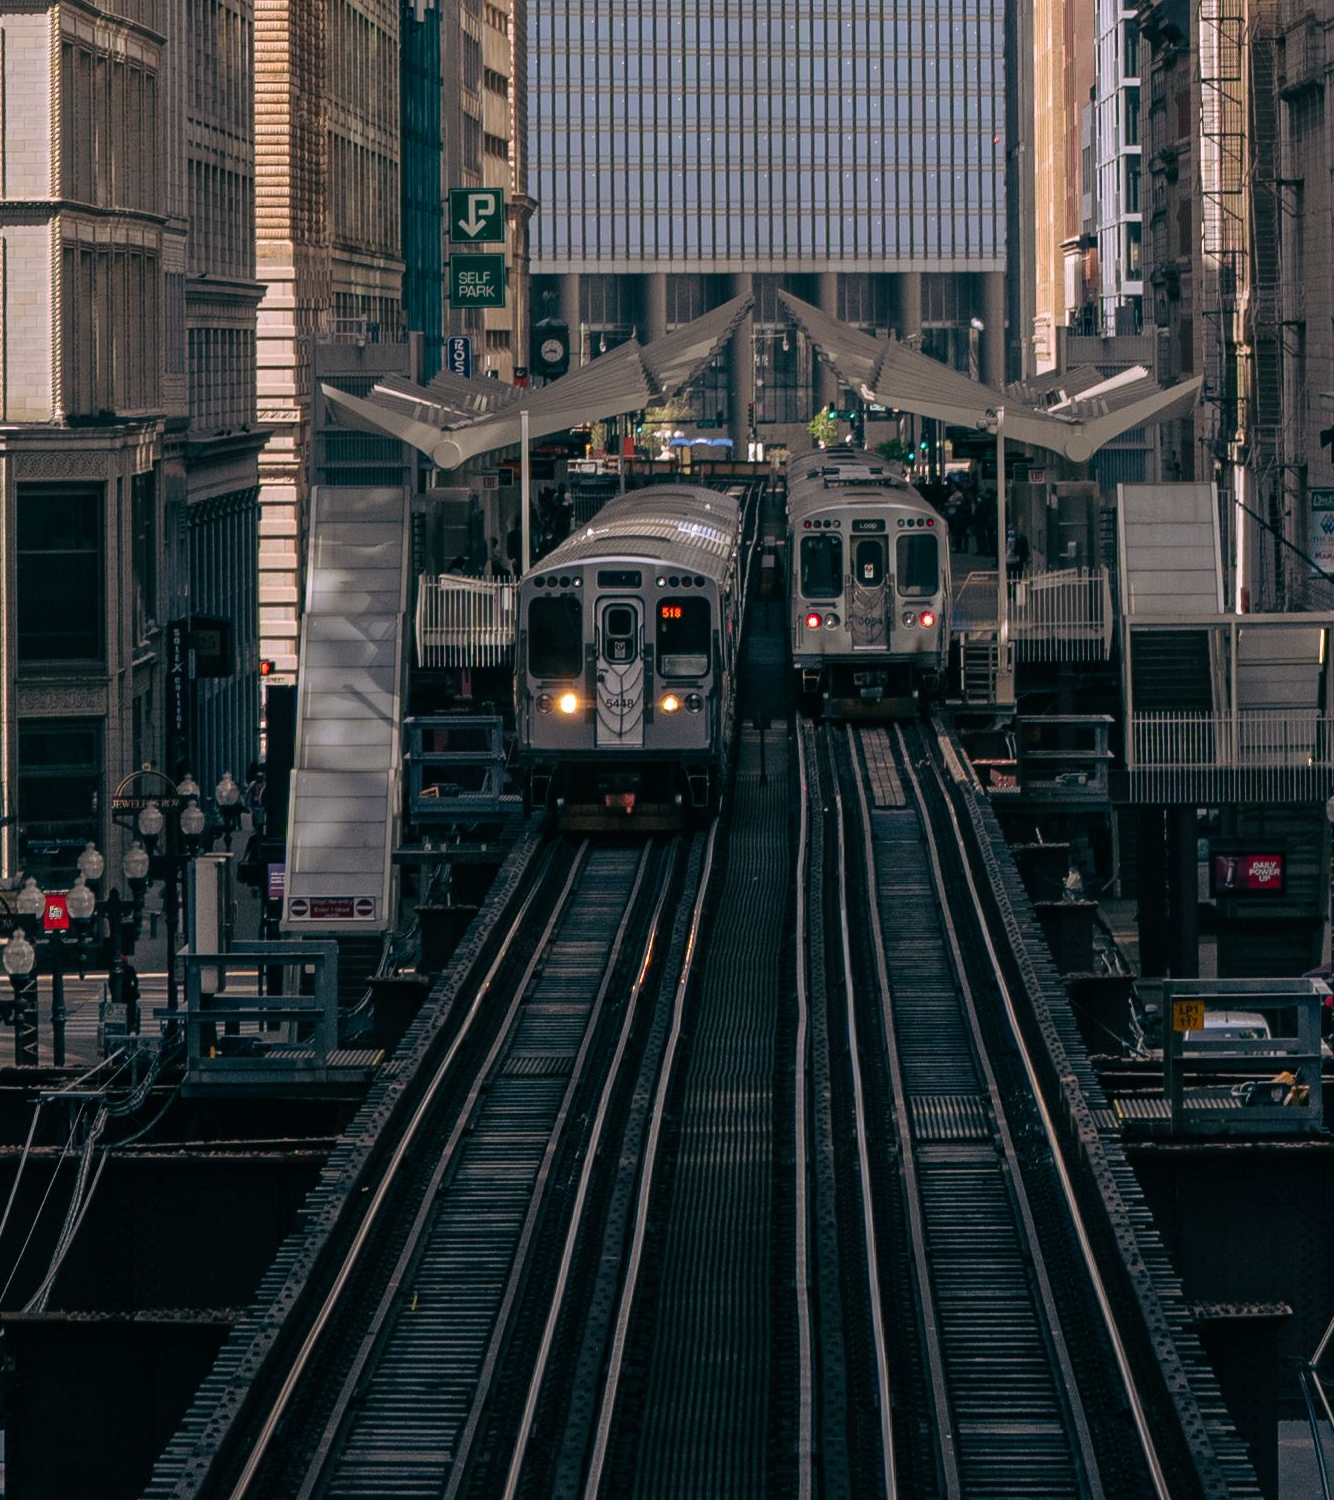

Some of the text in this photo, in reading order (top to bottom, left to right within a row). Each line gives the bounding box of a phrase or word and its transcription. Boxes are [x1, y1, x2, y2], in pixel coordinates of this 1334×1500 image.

[459, 271, 491, 285] SELF
[459, 285, 495, 298] PARK
[453, 339, 465, 376] ROS
[661, 606, 683, 618] 518
[605, 698, 634, 708] 5448
[1253, 861, 1277, 869] DAILY
[1249, 868, 1281, 876] POWER
